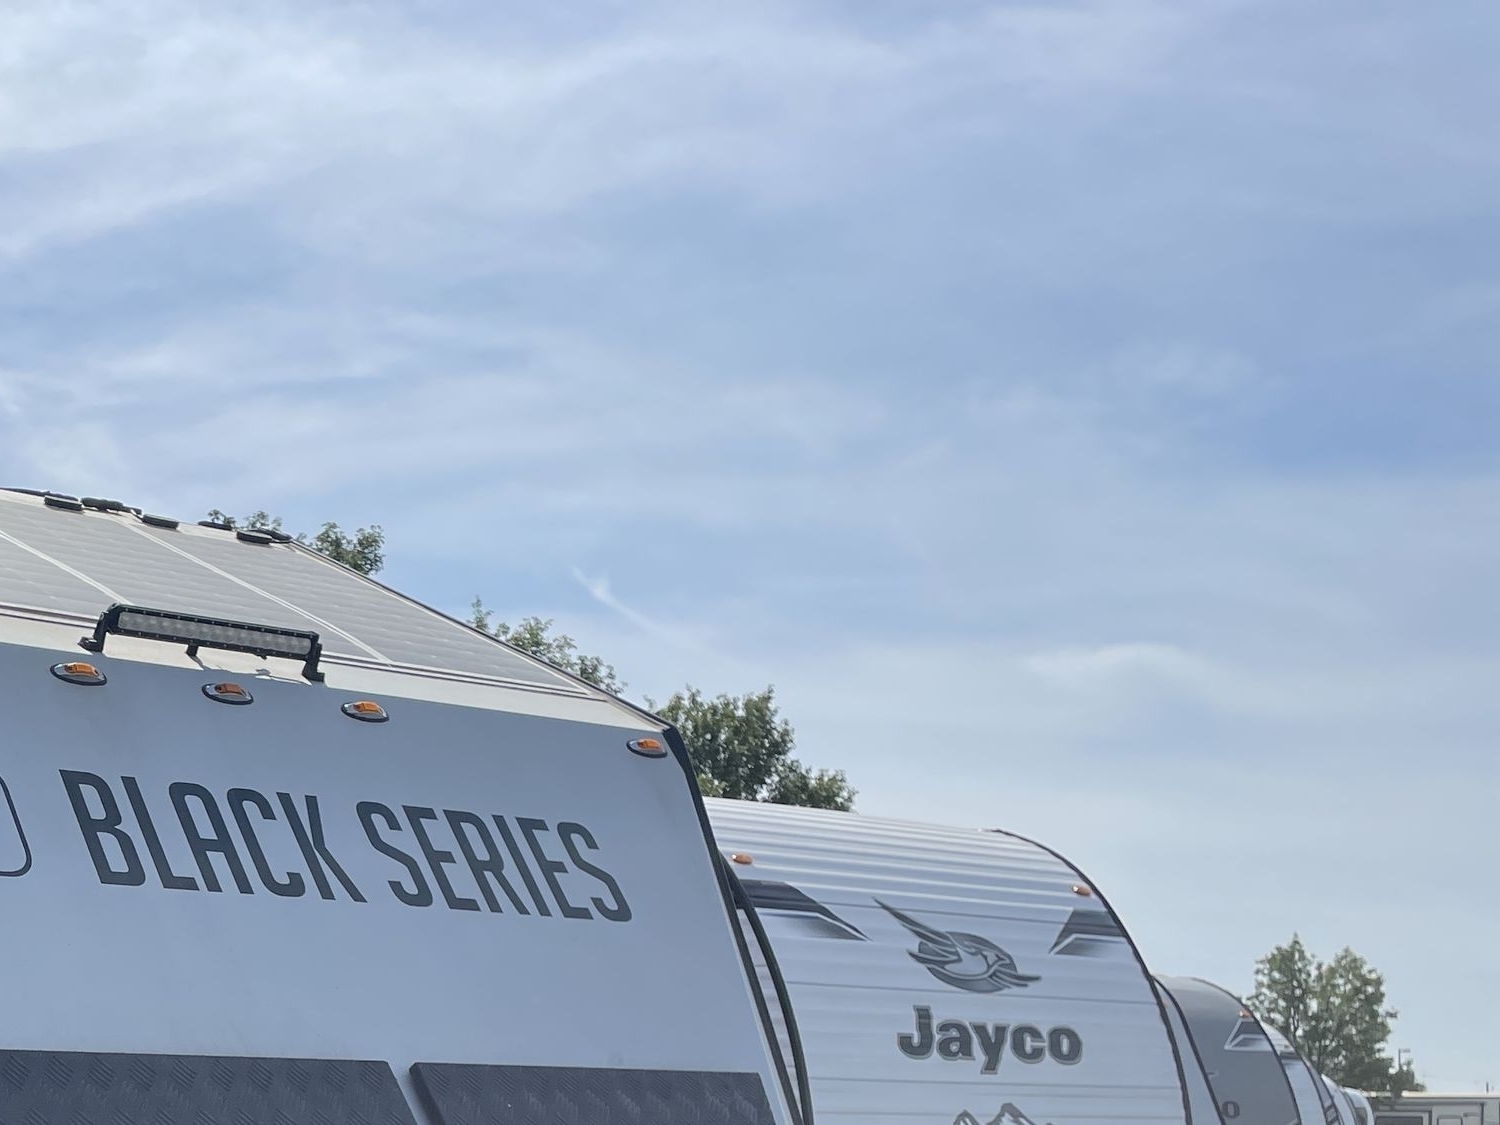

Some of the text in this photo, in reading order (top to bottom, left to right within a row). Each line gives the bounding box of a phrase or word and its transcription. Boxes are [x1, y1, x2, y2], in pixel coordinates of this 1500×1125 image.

[59, 769, 633, 922] BLACK SERIES
[897, 1005, 1084, 1075] Jayco
